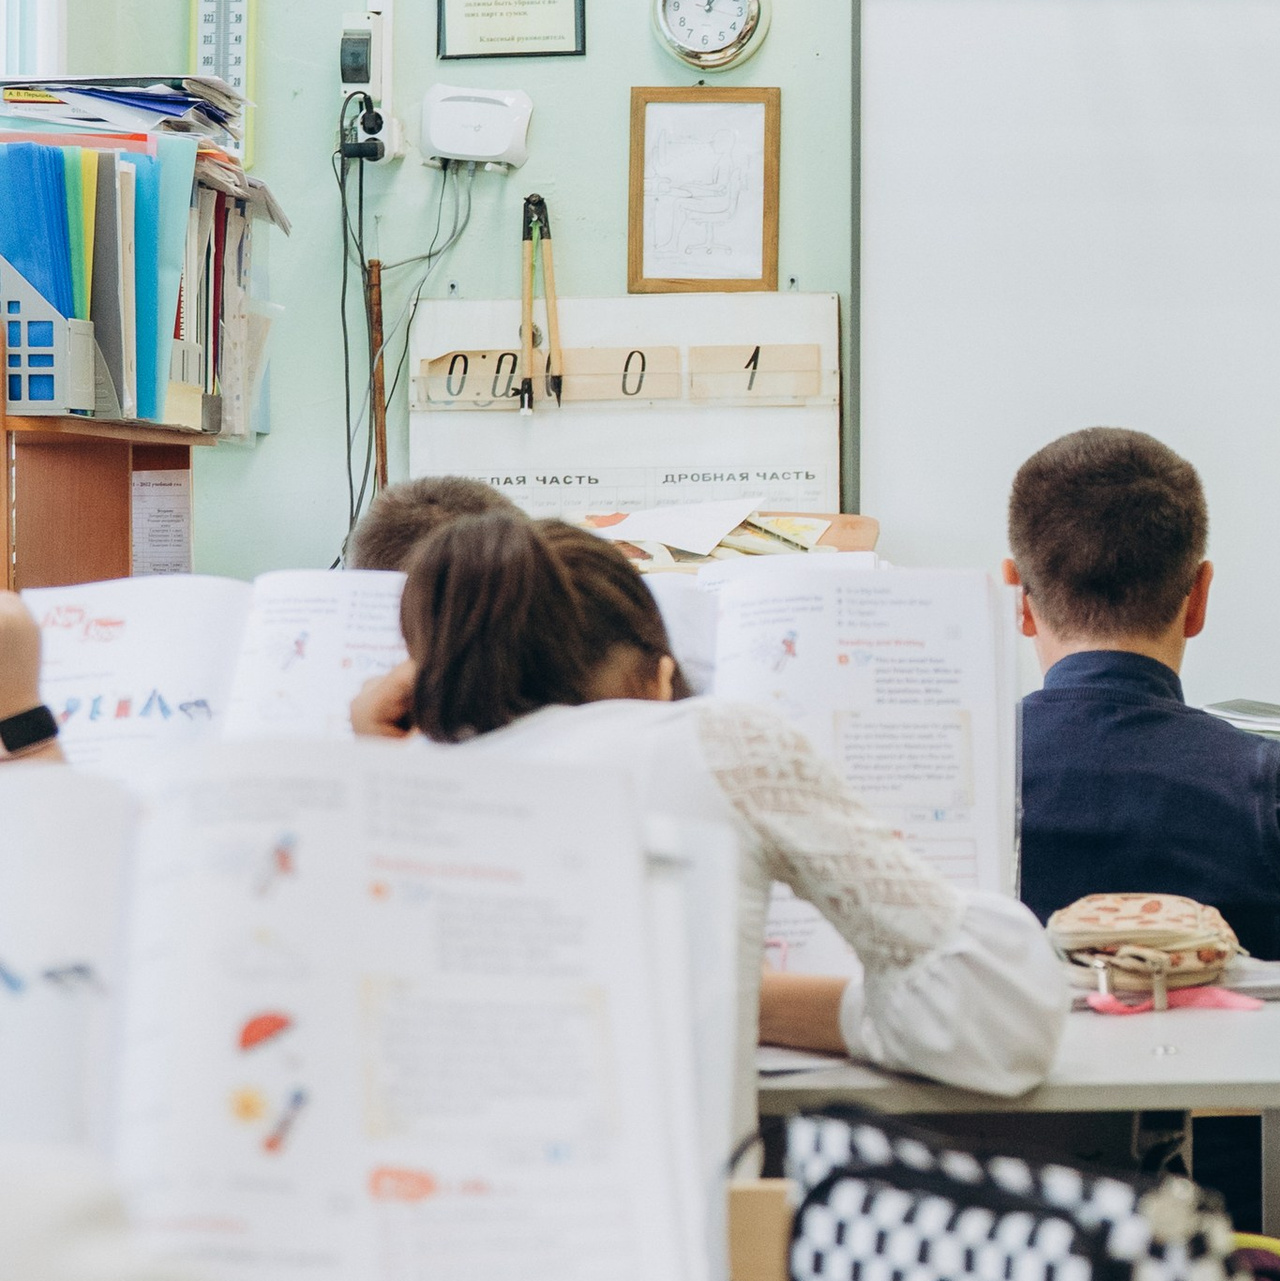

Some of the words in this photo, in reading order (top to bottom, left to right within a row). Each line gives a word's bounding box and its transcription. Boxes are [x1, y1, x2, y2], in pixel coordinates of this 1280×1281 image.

[673, 2, 680, 11] 9
[737, 7, 744, 17] 3
[203, 14, 214, 22] 323
[235, 14, 242, 22] 50
[678, 17, 686, 27] 8
[730, 22, 736, 31] 4
[687, 28, 694, 38] 7
[718, 31, 725, 41] 5
[203, 35, 213, 44] 313
[234, 35, 242, 44] 40
[702, 35, 709, 45] 6
[202, 56, 213, 65] 303
[234, 56, 242, 65] 30
[234, 77, 241, 86] 20
[622, 350, 646, 396] 0
[744, 345, 761, 391] 1
[535, 475, 600, 486] ЧАСТЬ
[662, 472, 750, 484] ДРОБНАЯ
[756, 470, 816, 481] ЧАСТЬ
